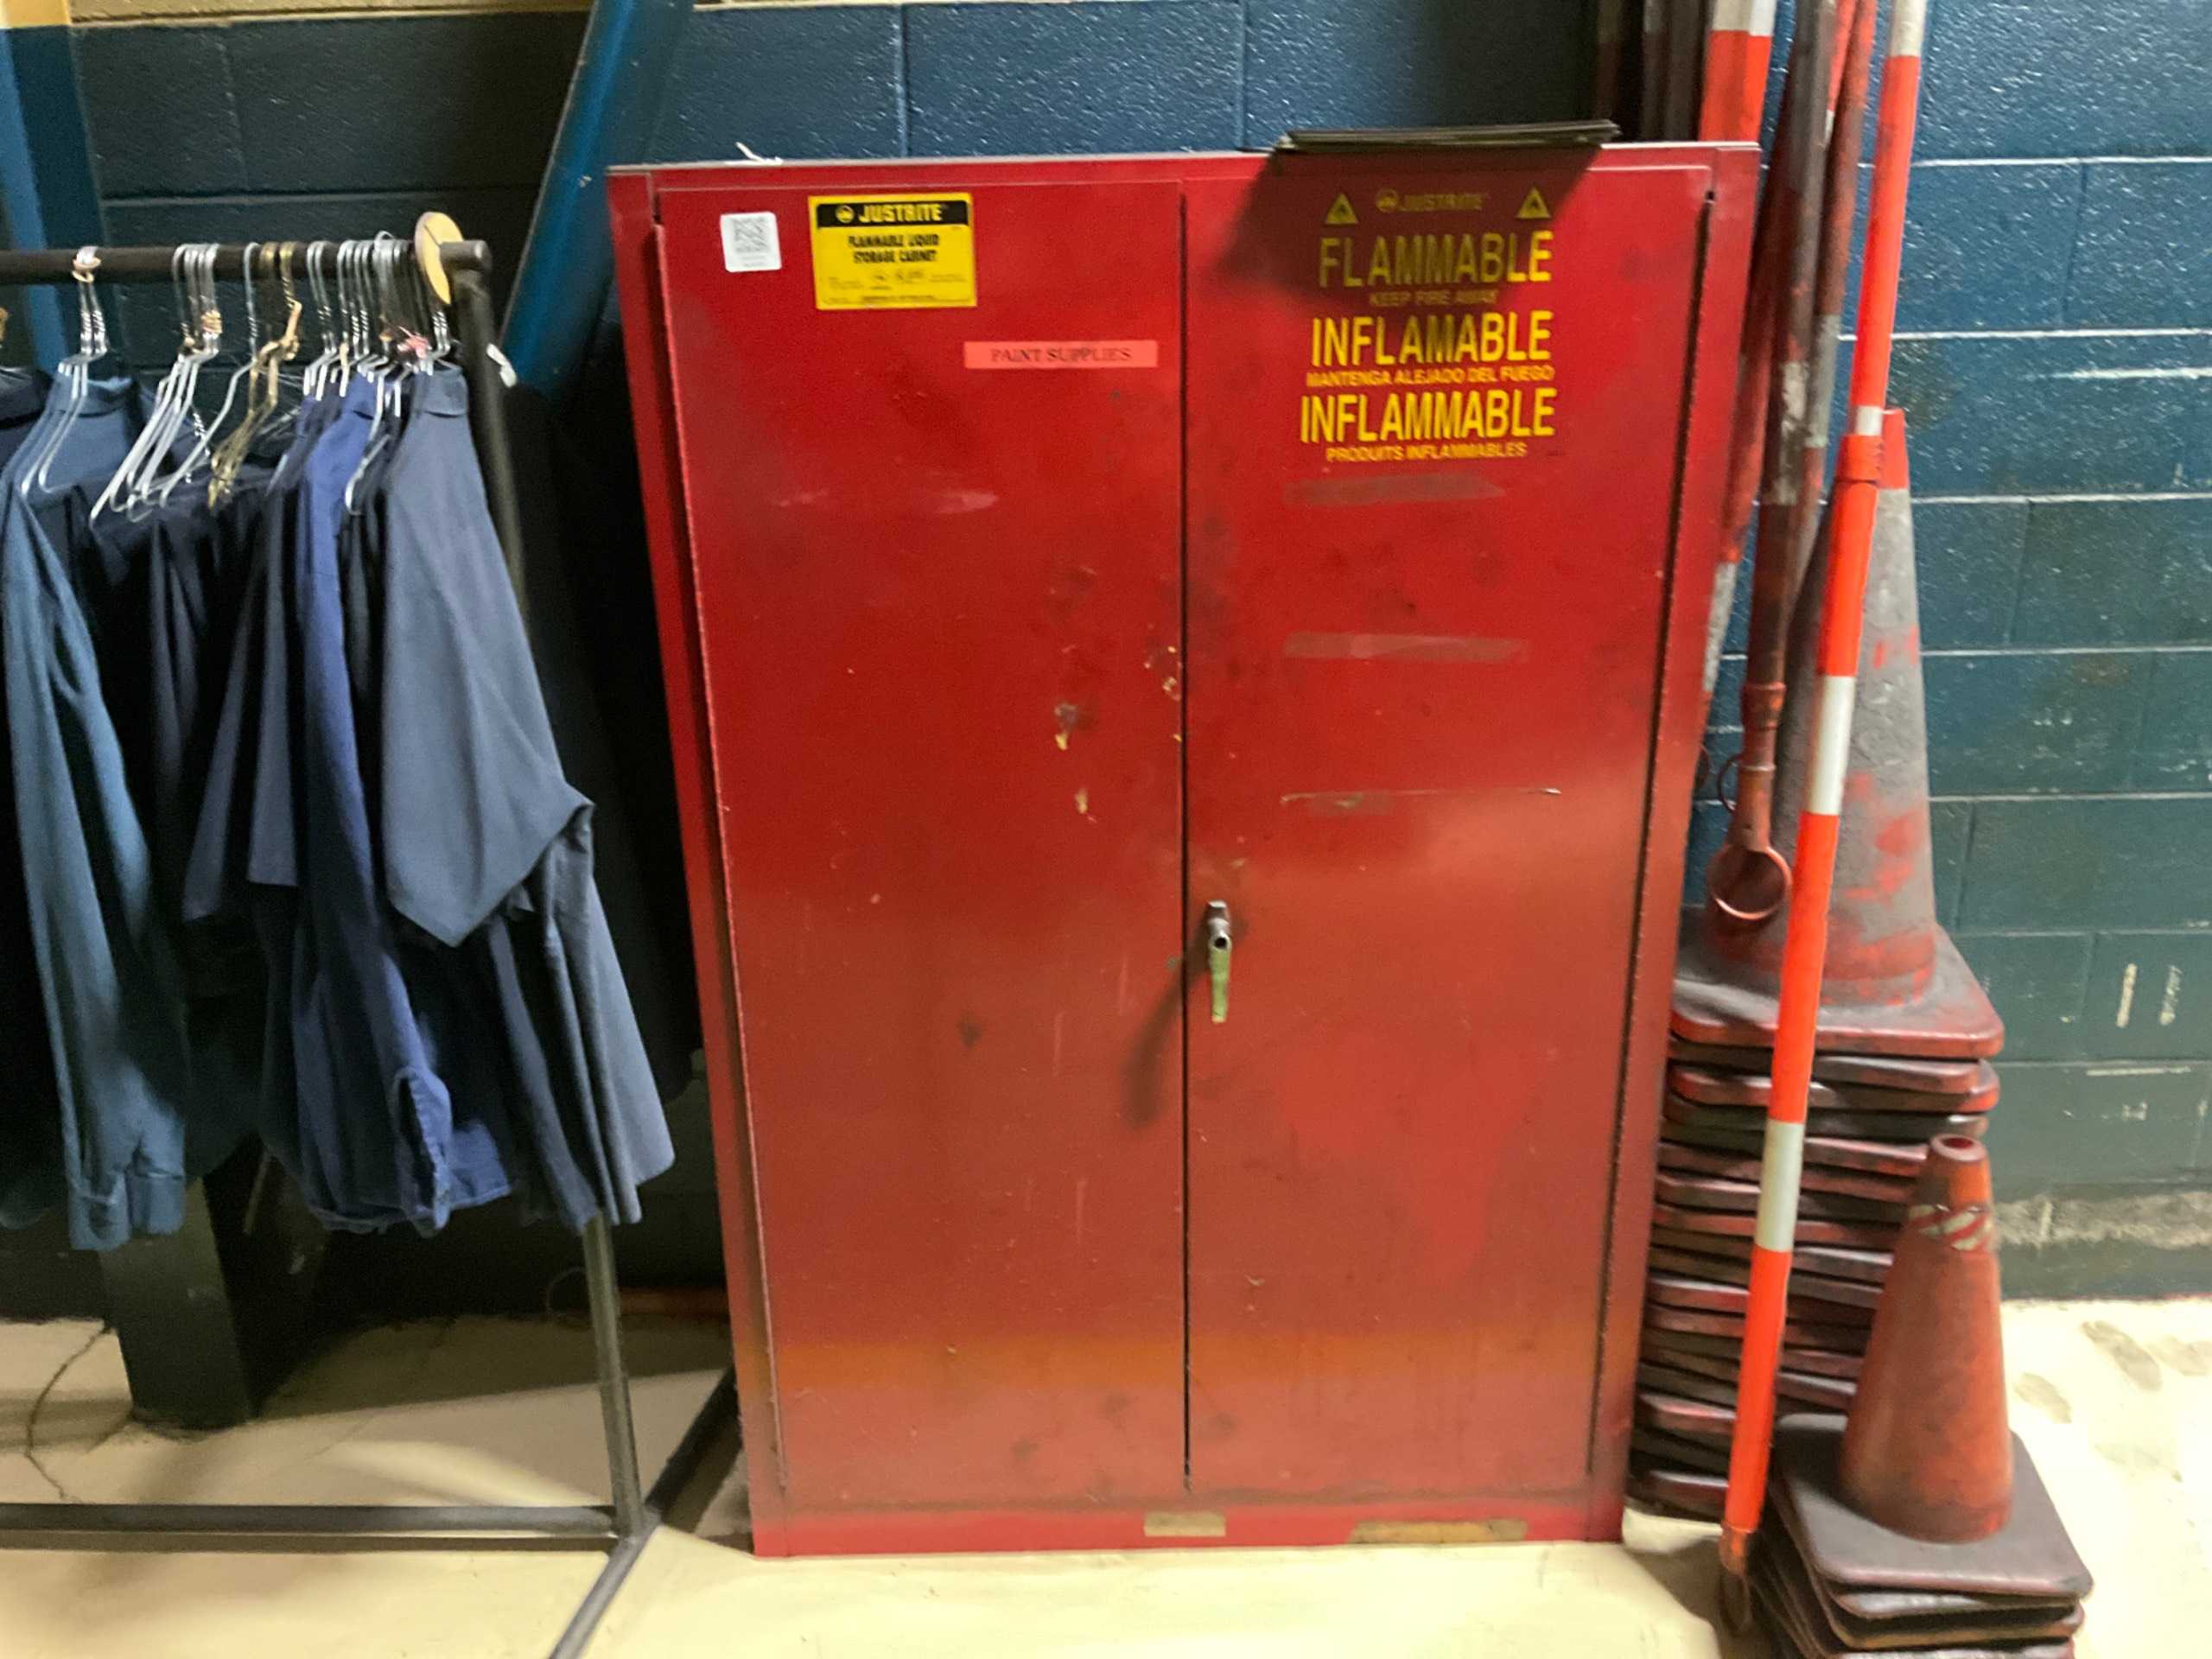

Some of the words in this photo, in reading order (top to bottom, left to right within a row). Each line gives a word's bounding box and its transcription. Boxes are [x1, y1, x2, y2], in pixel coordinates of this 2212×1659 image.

[858, 204, 943, 223] JUSTRITE
[1319, 230, 1554, 288] FLAMMABLE
[1312, 310, 1554, 367] INFLAMABLE
[991, 348, 1041, 362] PAINT
[1046, 347, 1132, 361] SUPPLIES
[1306, 370, 1392, 387] MANTENGA
[1394, 367, 1465, 385] ALEJADO
[1467, 366, 1497, 383] DEL
[1501, 365, 1554, 382] FUEGO
[1300, 388, 1557, 443] INFLAMMABLE
[1326, 446, 1404, 463] PRODUITS
[1406, 442, 1528, 460] INFLAMMABLES
